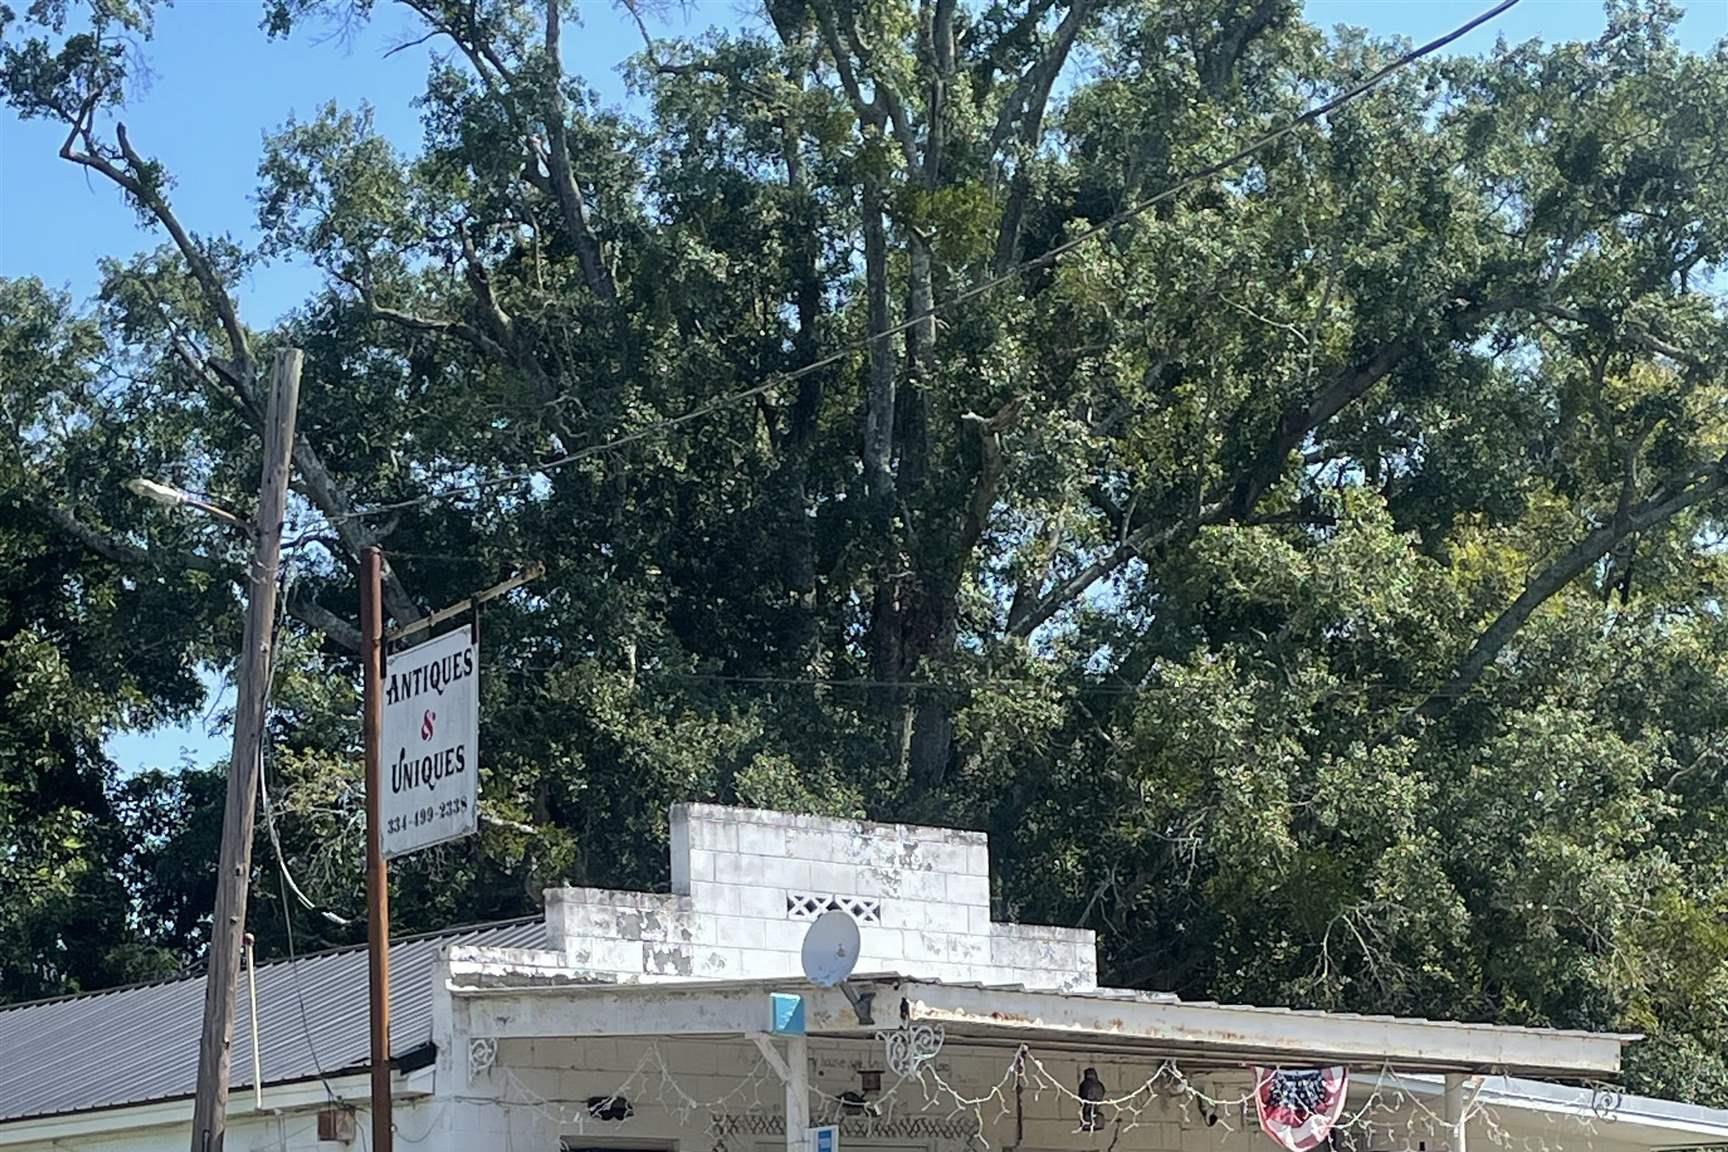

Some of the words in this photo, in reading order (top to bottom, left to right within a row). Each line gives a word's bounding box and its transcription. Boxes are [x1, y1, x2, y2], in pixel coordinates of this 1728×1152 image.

[387, 648, 473, 705] ANTIQUES
[420, 709, 436, 742] &
[391, 745, 465, 794] UNIQUES
